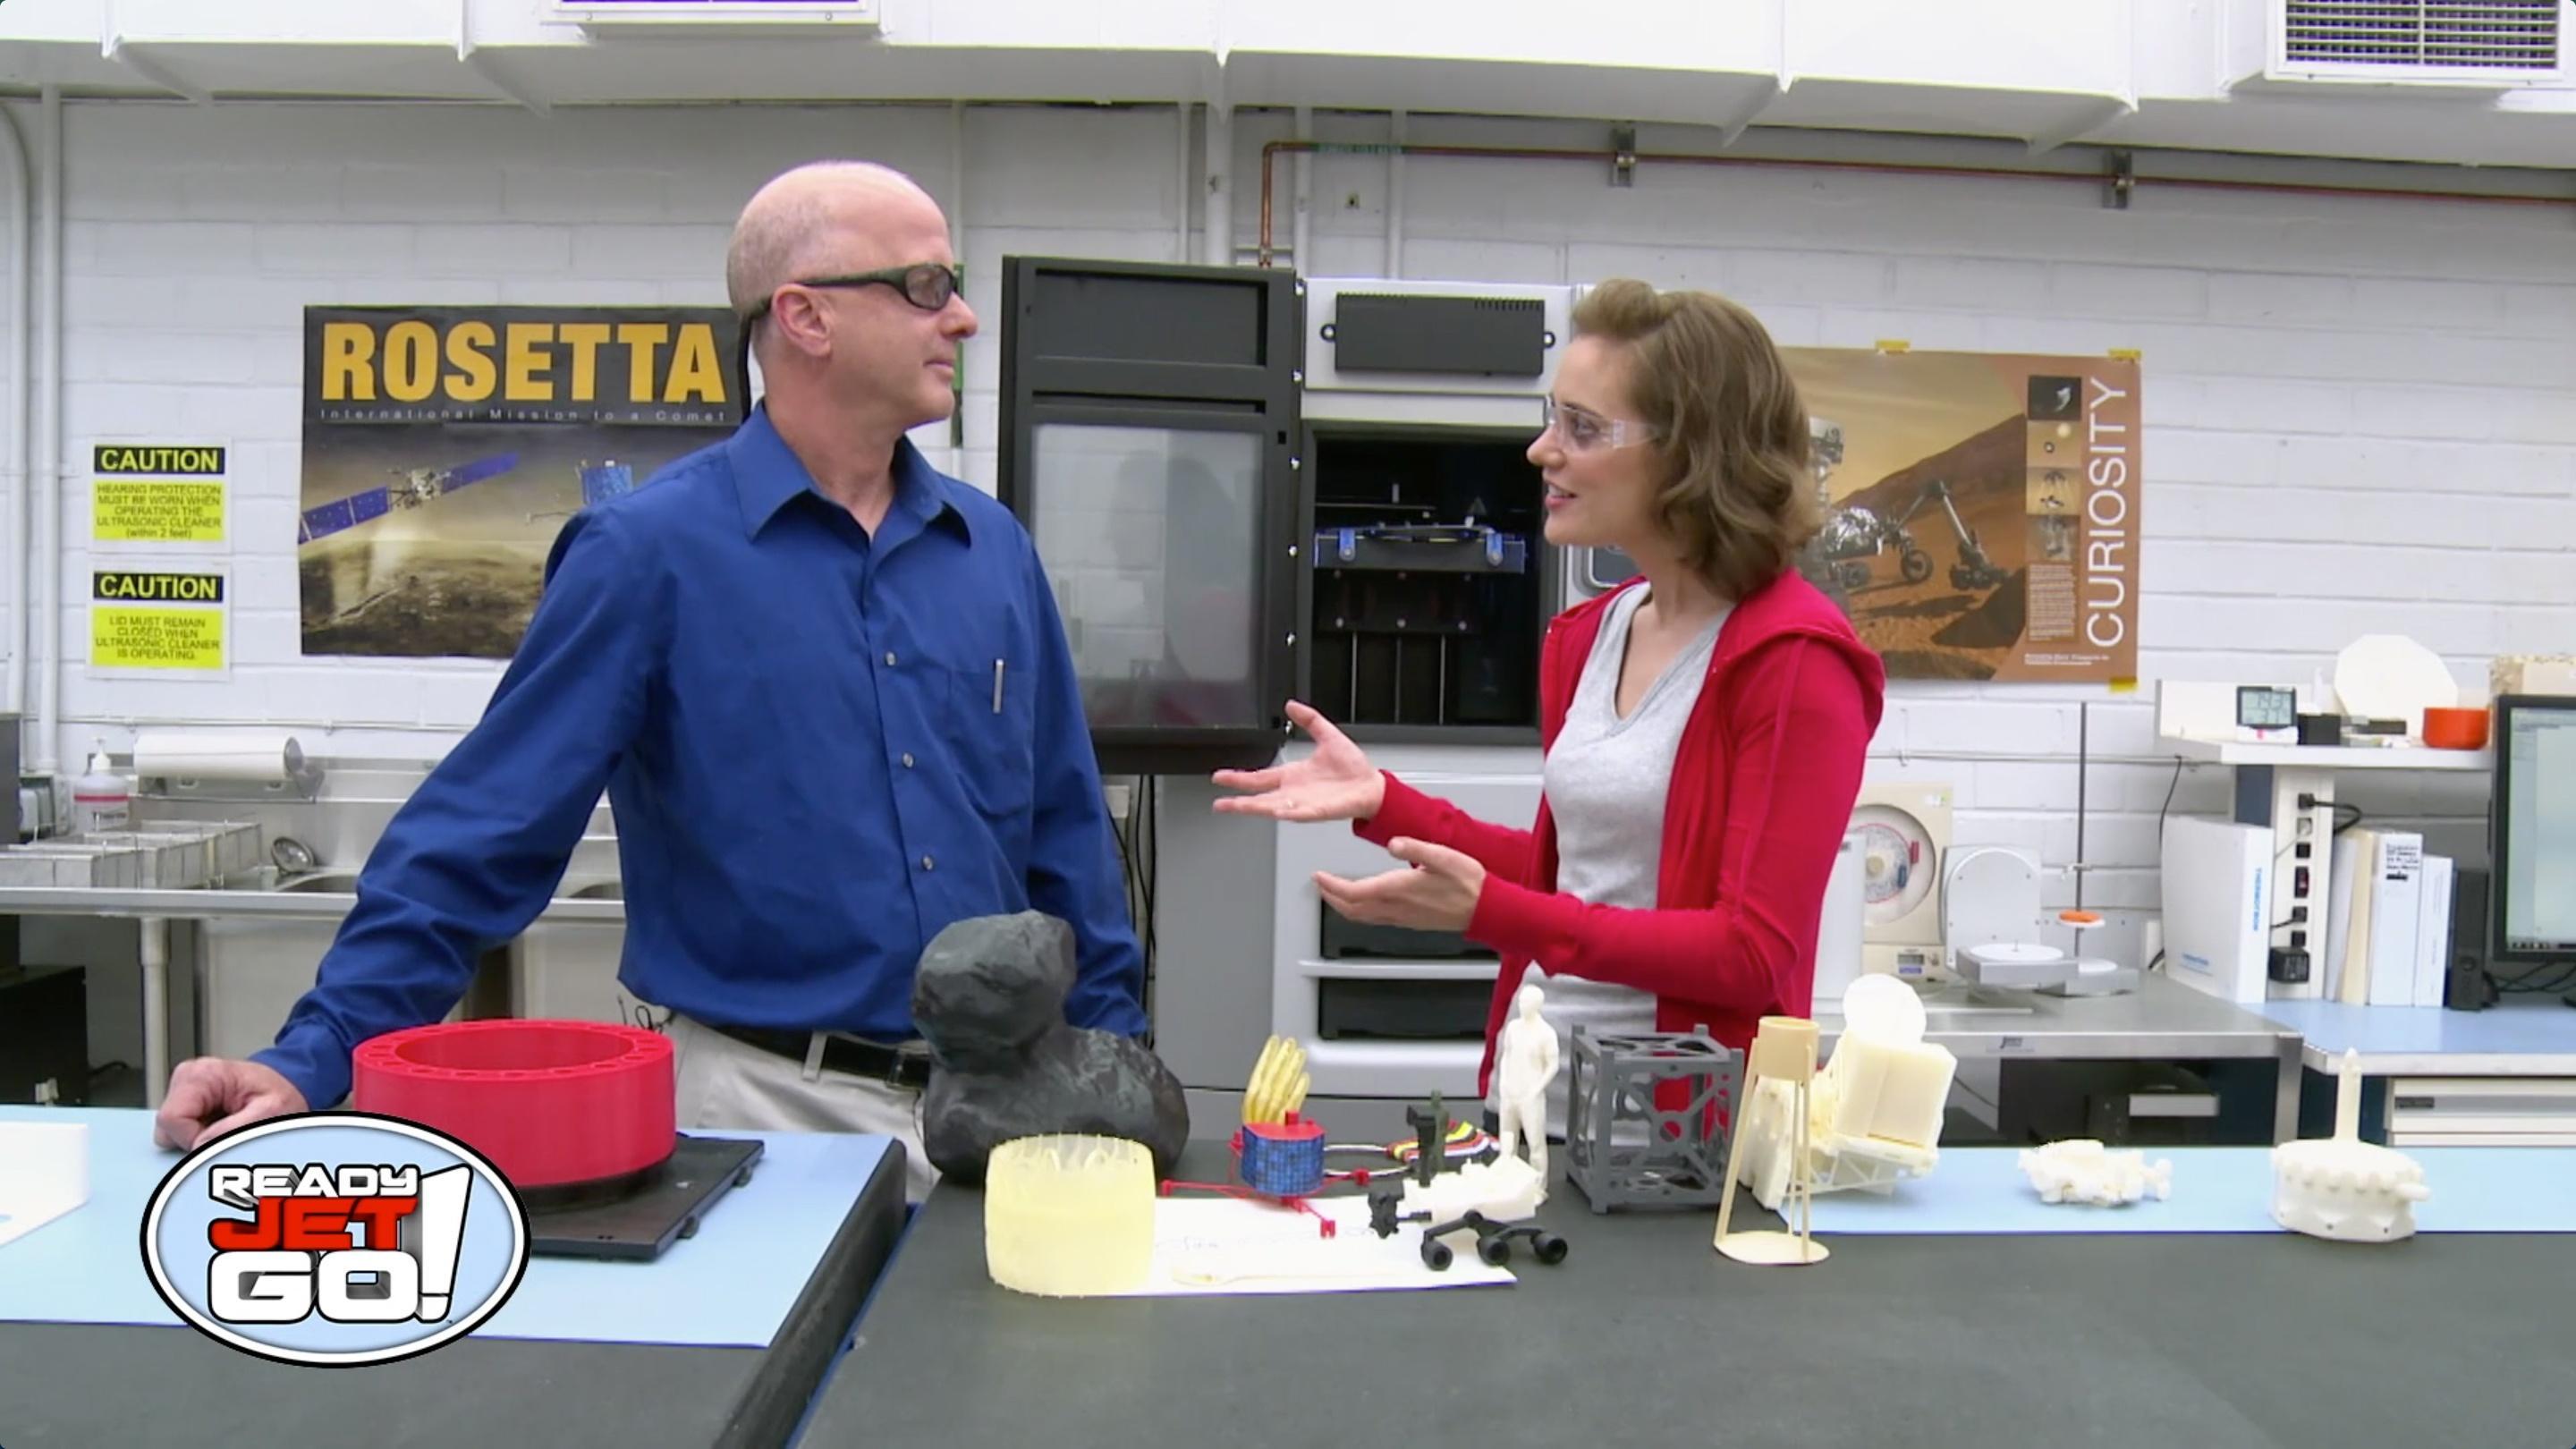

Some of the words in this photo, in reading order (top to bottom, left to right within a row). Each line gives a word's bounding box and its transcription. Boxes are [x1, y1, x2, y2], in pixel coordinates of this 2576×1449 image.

[320, 320, 727, 403] ROSETTA
[320, 409, 474, 420] International
[489, 409, 579, 421] Mission
[593, 411, 614, 421] to
[630, 411, 640, 421] a
[655, 411, 724, 422] Comet
[100, 448, 218, 472] CAUTION
[96, 484, 148, 495] HEARING
[149, 484, 222, 496] PROTECTION
[97, 495, 129, 504] MUST
[132, 496, 147, 504] BE
[148, 496, 183, 505] WORN
[186, 496, 221, 506] WHEN
[114, 505, 179, 516] OPERATING
[181, 506, 203, 516] THE
[2086, 377, 2126, 648] CURIOSITY
[96, 516, 168, 527] ULTRASONIC
[169, 517, 222, 528] CLEANER
[125, 528, 158, 538] (within
[159, 528, 167, 538] 2
[169, 528, 192, 539] feet)
[98, 574, 217, 599] CAUTION
[108, 615, 128, 626] LID
[129, 616, 161, 626] MUST
[163, 617, 206, 628] REMAIN
[116, 627, 163, 638] CLOSED
[165, 629, 199, 639] WHEN
[95, 637, 165, 648] ULTRASONIC
[167, 639, 220, 650] CLEANER
[116, 648, 129, 658] IS
